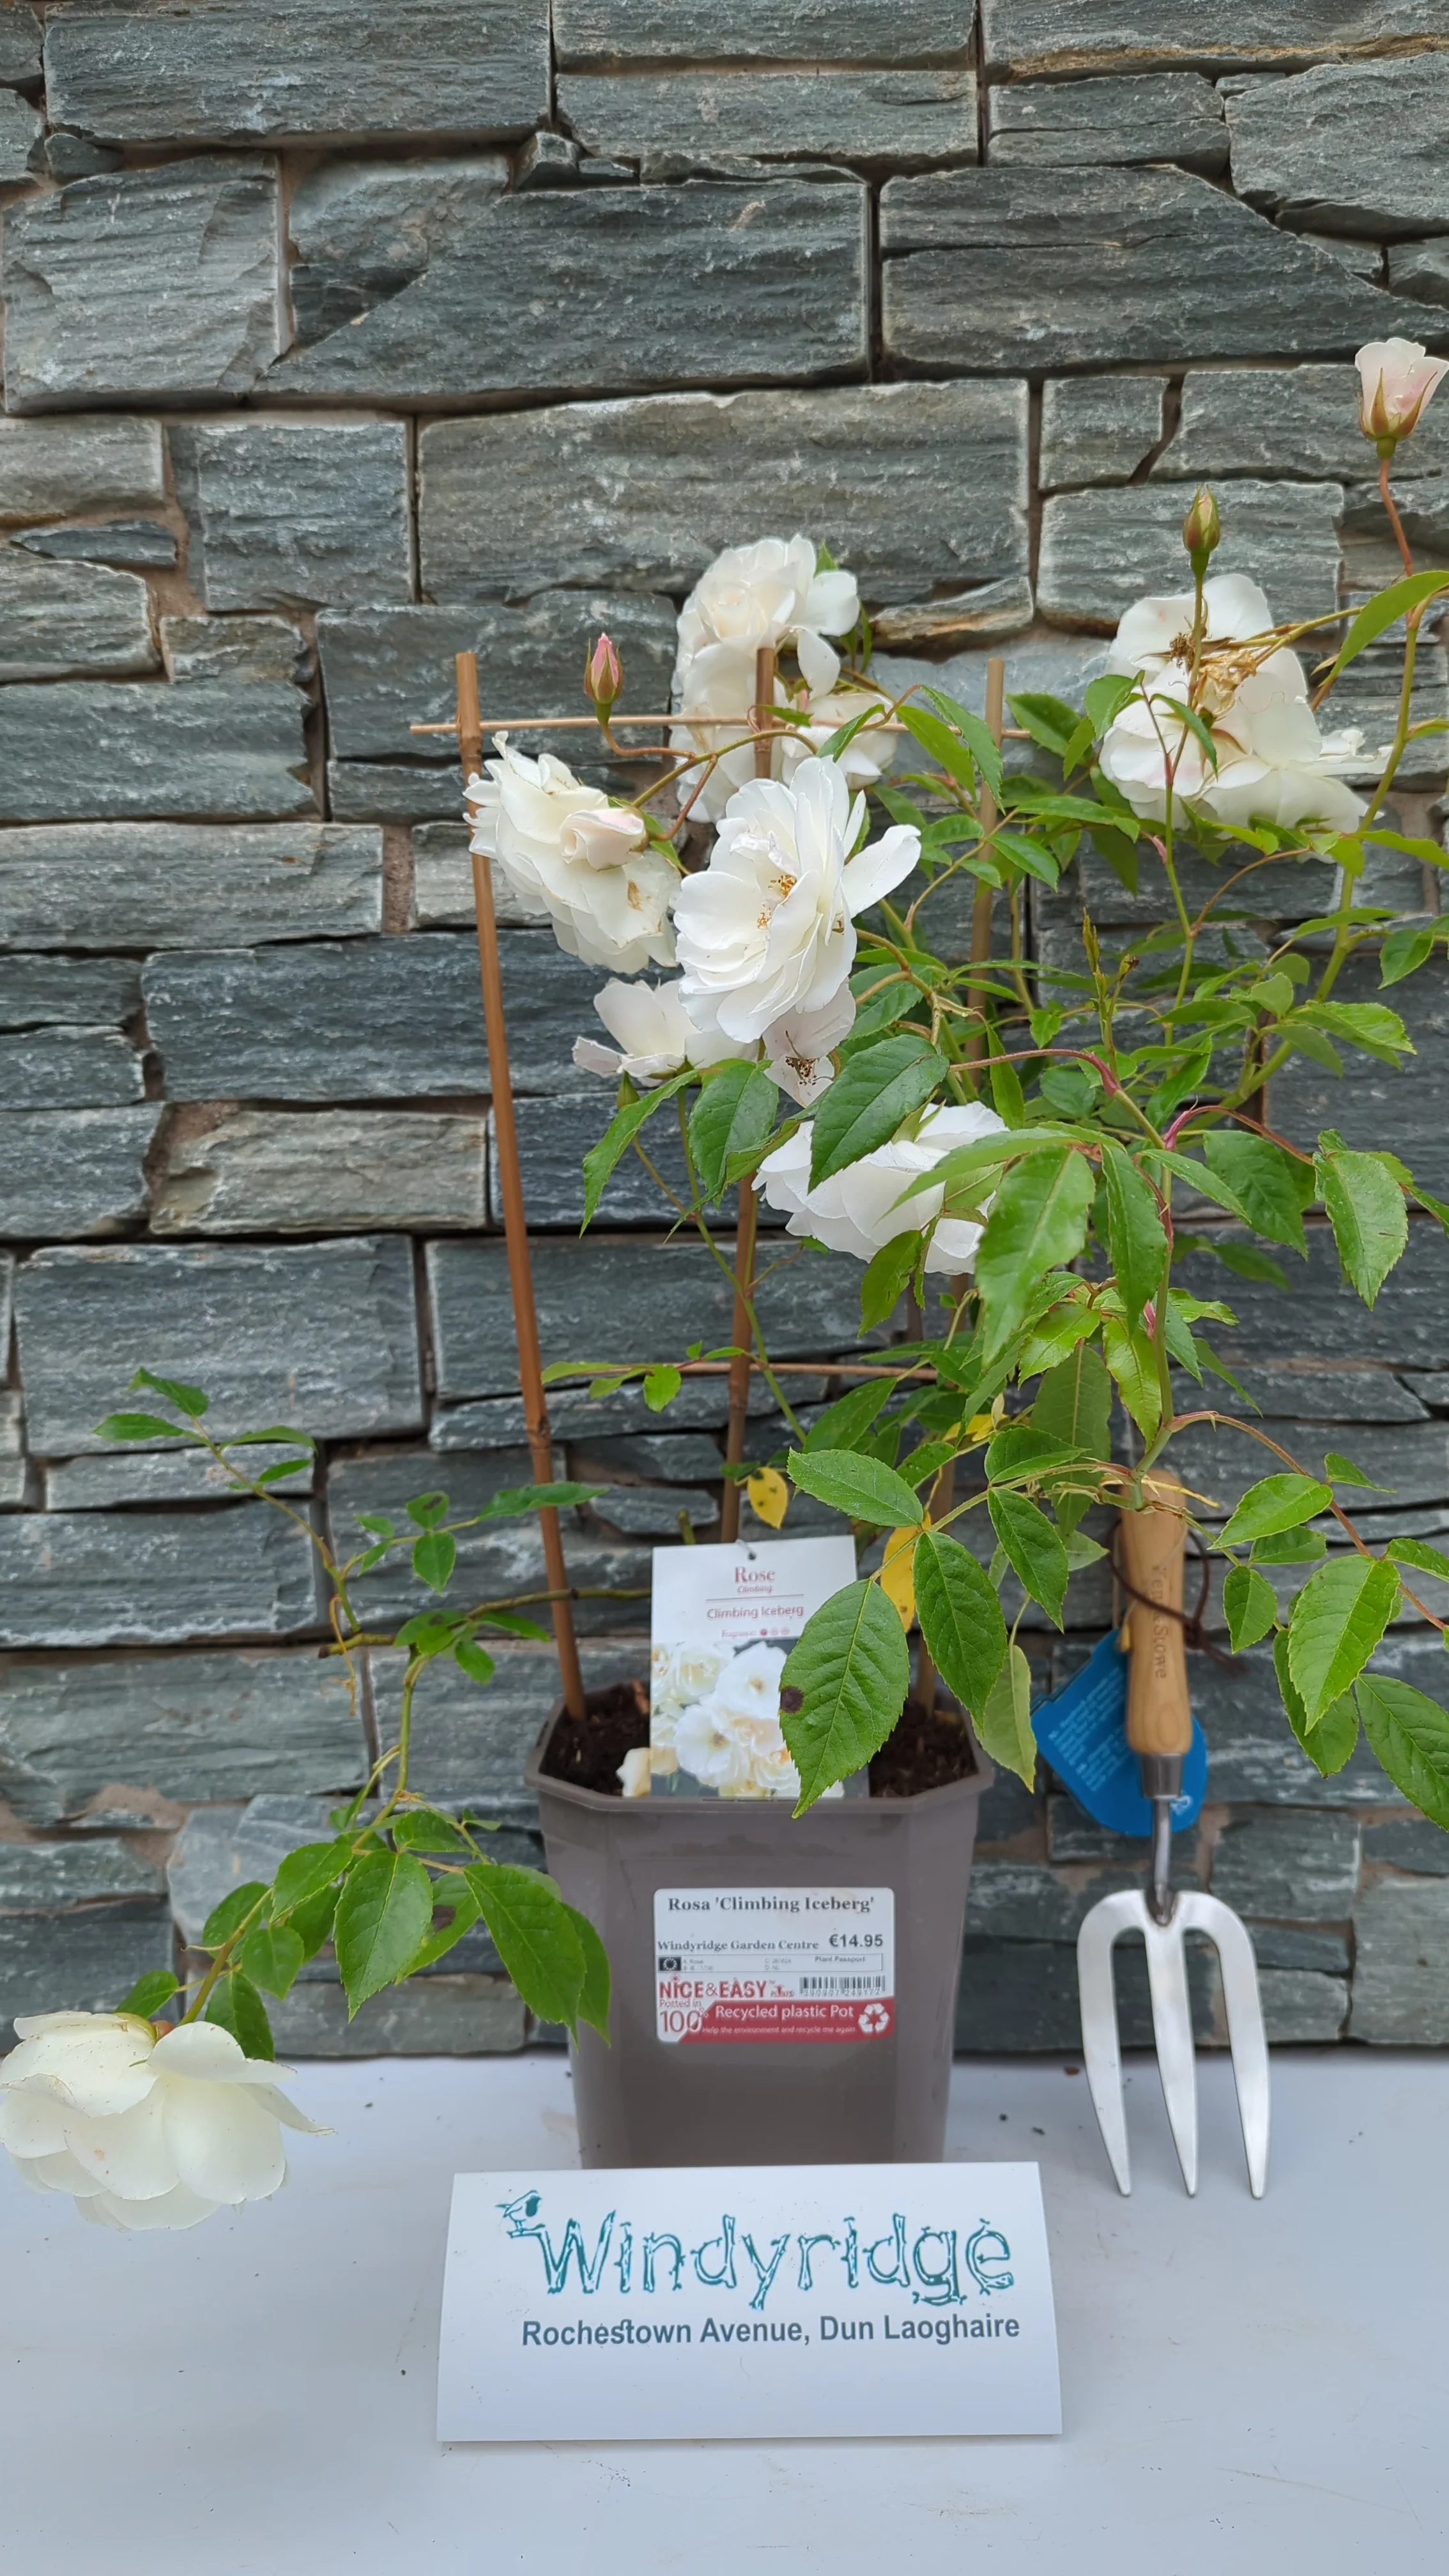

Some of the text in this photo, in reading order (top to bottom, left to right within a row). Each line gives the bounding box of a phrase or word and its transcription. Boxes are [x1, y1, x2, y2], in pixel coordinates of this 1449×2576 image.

[735, 1566, 776, 1583] Rose
[737, 1585, 772, 1593] Climbing
[707, 1606, 804, 1619] Climbing Iceberg
[668, 1896, 874, 1912] Rosa 'Climbing Iceberg'
[657, 1934, 884, 1952] Windyridge Garden Centre €14.95
[834, 1955, 866, 1963] Passport
[659, 1999, 702, 2008] Potted in
[715, 2004, 854, 2021] Recycled plastic Pot
[703, 2026, 719, 2035] Help
[509, 2209, 1015, 2310] Windyridge
[521, 2312, 1021, 2347] Rochestown Avenue, Dun Laoghaire
